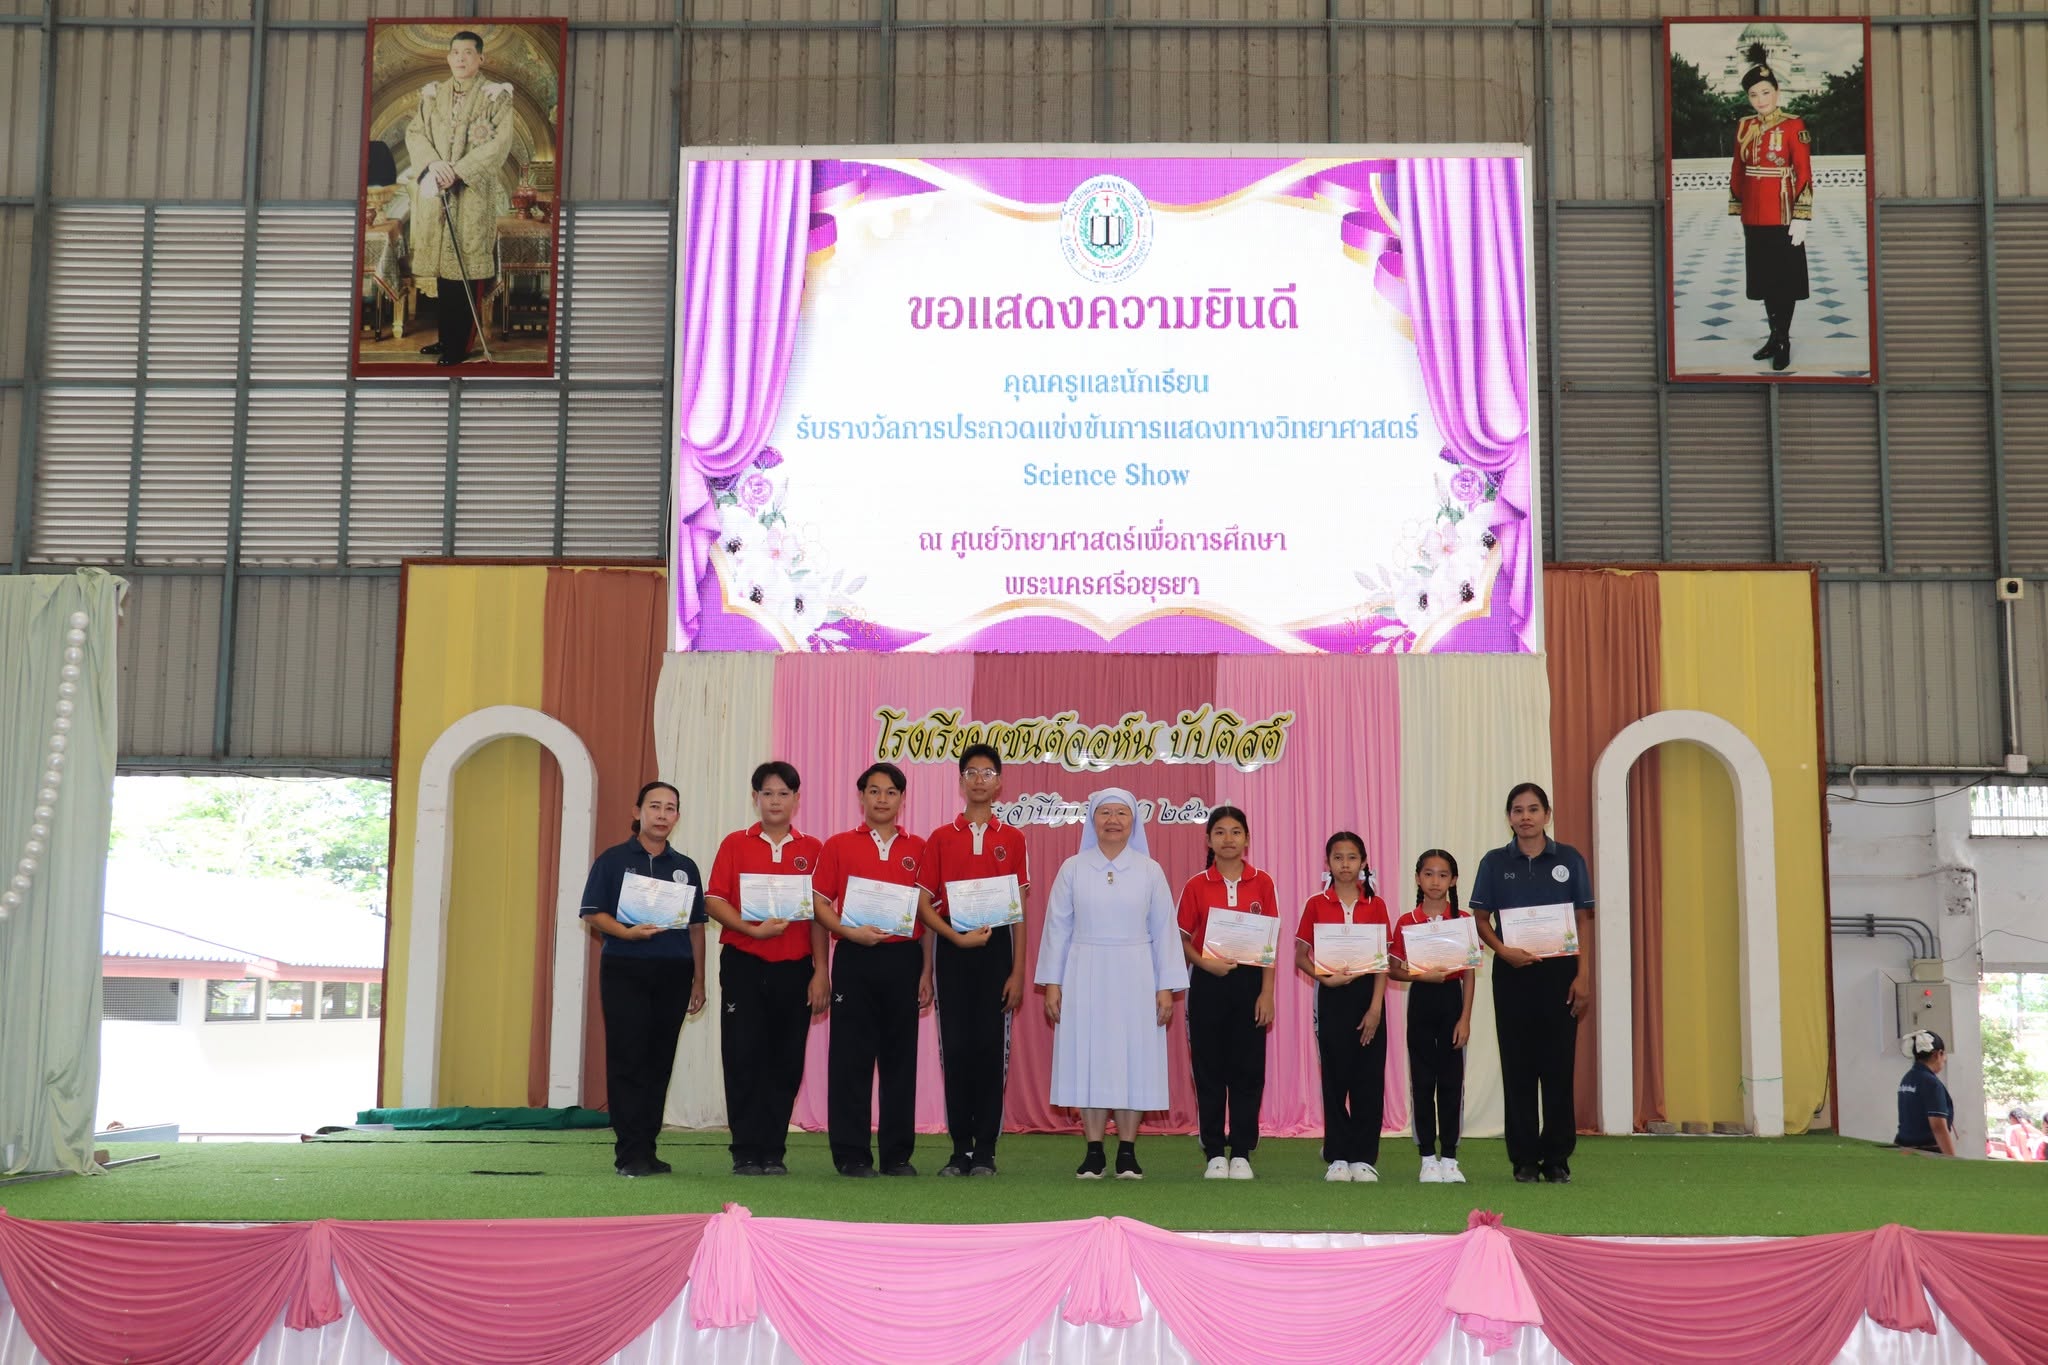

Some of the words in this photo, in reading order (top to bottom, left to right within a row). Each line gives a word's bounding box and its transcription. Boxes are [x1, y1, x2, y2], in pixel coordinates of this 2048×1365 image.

[908, 283, 1299, 330] ขอแสดงความยินดี
[1003, 367, 1209, 402] คุณครูและนักเรียน
[796, 412, 1419, 440] รับรางวัลการประกวดแข่งขันการแสดงทางวิทยาศาสตร์
[1023, 463, 1117, 486] Science
[1125, 463, 1190, 486] Show
[919, 531, 943, 551] ณ
[951, 519, 1287, 560] ศูนย์วิทยาศาสตร์เพื่อการศึกษา
[1171, 705, 1293, 767] บัปติสต์
